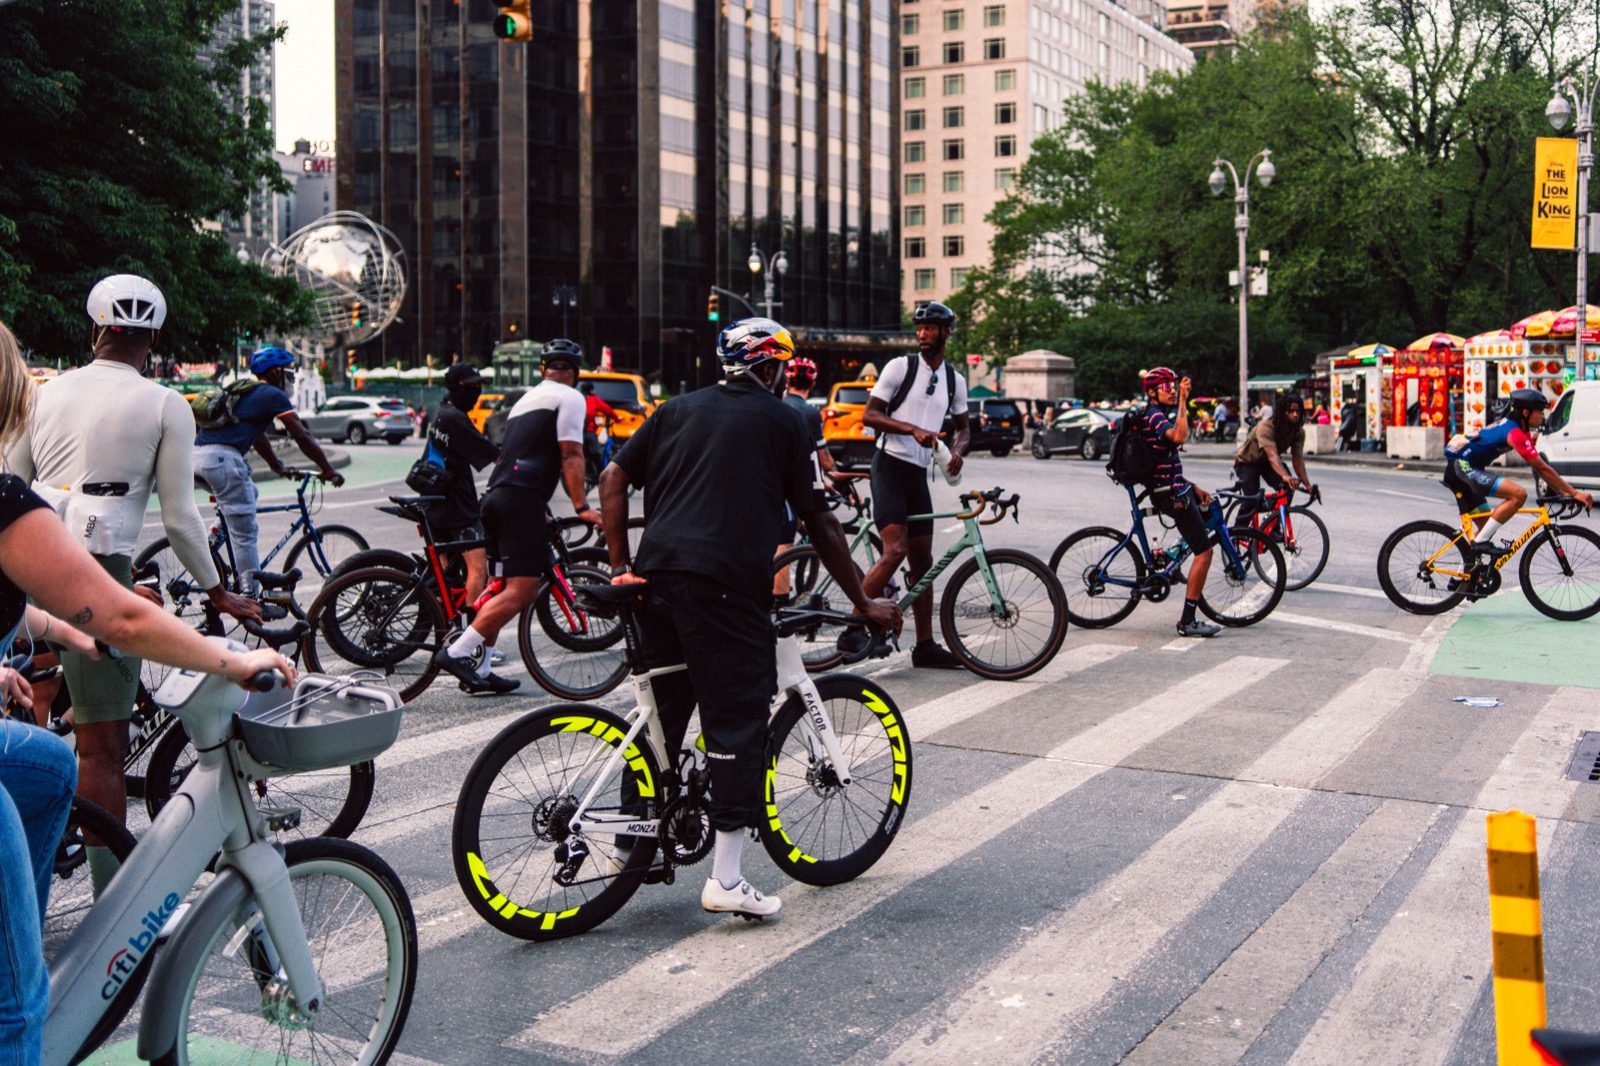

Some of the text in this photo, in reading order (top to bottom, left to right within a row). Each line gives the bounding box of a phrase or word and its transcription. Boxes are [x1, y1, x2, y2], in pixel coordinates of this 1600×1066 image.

[1546, 169, 1566, 179] THE
[1541, 182, 1569, 199] LION
[1537, 201, 1571, 219] KING
[84, 515, 97, 538] MBO
[804, 692, 827, 732] FACTOR
[626, 823, 656, 834] MONZA
[101, 892, 180, 1001] citi bike
